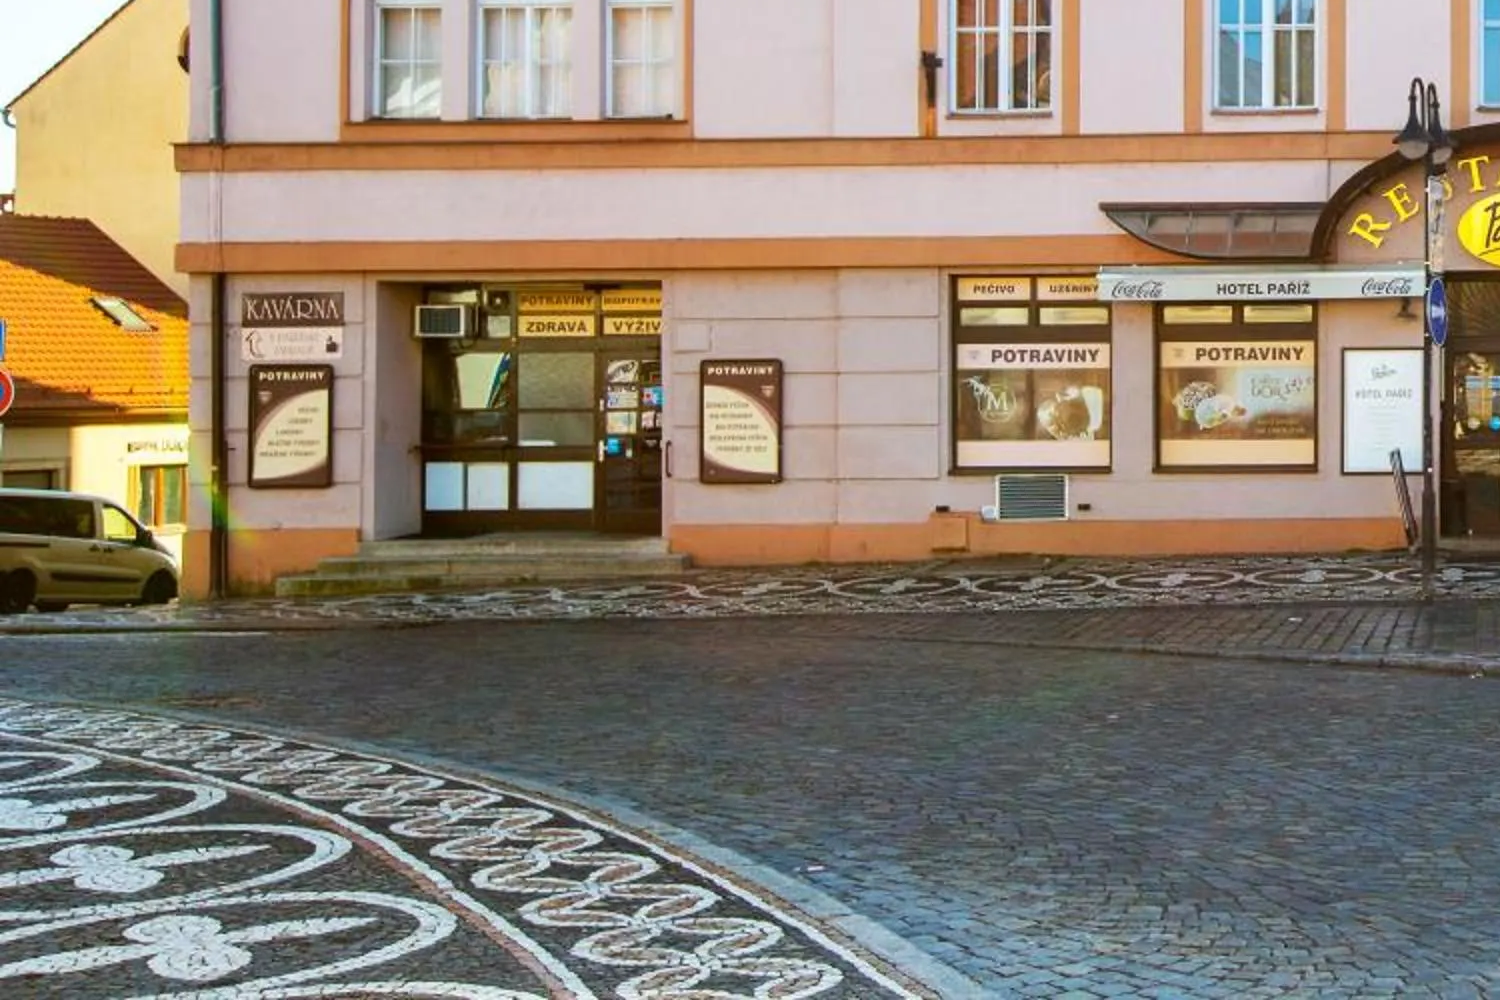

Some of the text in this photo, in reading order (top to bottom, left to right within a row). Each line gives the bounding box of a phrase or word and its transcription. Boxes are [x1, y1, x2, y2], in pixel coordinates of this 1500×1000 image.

[973, 282, 1016, 295] PEČIVO
[1217, 280, 1311, 295] HOTEL PAŘÍŽ
[243, 295, 340, 320] KAVÁRNA
[990, 349, 1100, 364] POTRAVINY
[1195, 347, 1304, 361] POTRAVINY
[258, 371, 325, 381] POTRAVINY
[707, 366, 774, 376] POTRAVINY
